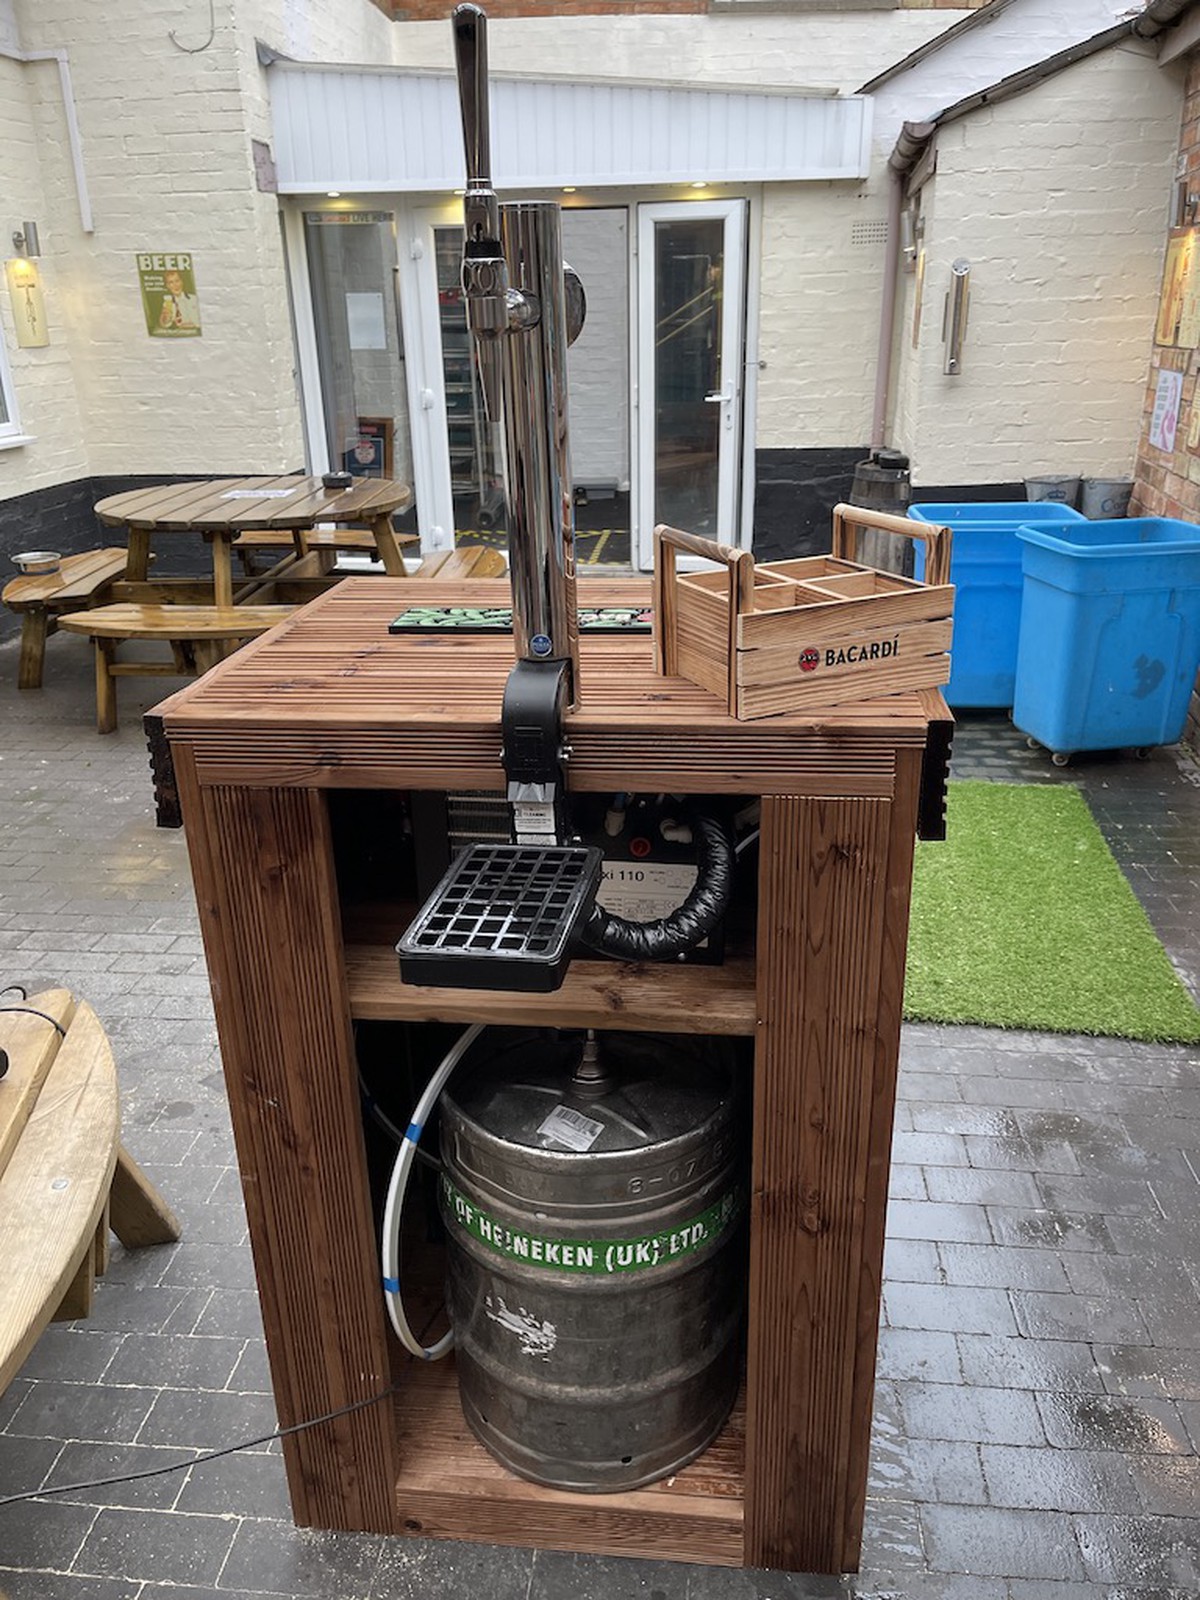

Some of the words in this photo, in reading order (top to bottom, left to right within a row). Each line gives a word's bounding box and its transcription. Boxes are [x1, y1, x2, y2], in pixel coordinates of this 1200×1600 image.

[139, 255, 191, 271] BEER
[826, 634, 899, 666] BACARDÍ
[619, 870, 645, 881] 110
[454, 1195, 474, 1225] OF
[479, 1217, 594, 1267] HEINEKEN
[605, 1239, 660, 1272] (UK)
